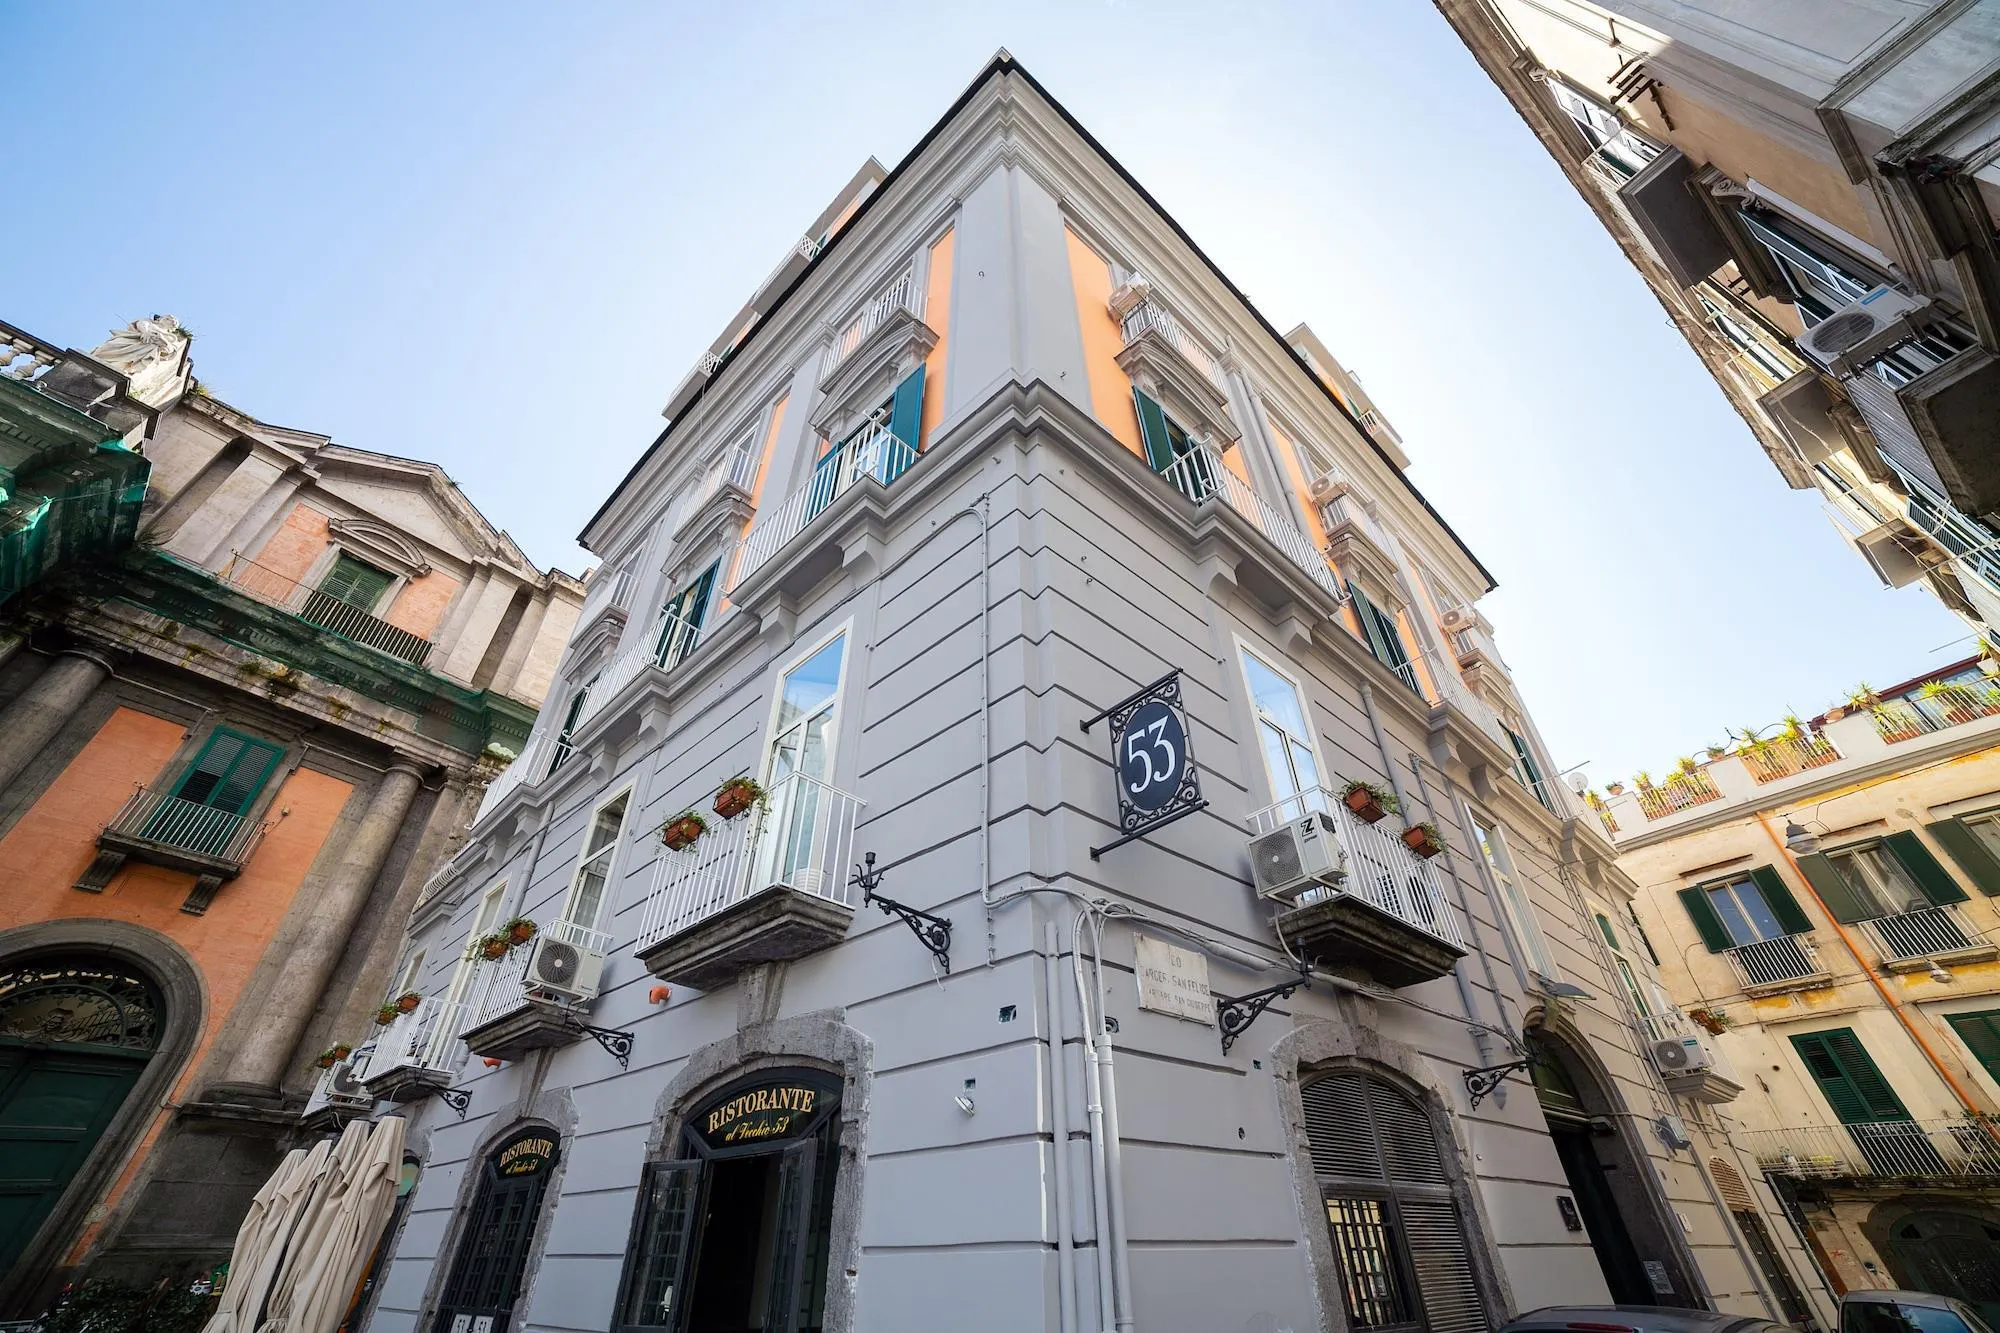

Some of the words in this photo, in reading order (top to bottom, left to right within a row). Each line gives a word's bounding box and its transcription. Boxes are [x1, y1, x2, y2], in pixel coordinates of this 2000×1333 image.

[1127, 714, 1176, 794] 53
[707, 1087, 816, 1135] RISTORANTE
[725, 1125, 738, 1142] al
[772, 1115, 790, 1134] 53
[499, 1138, 554, 1168] RISTORANTE
